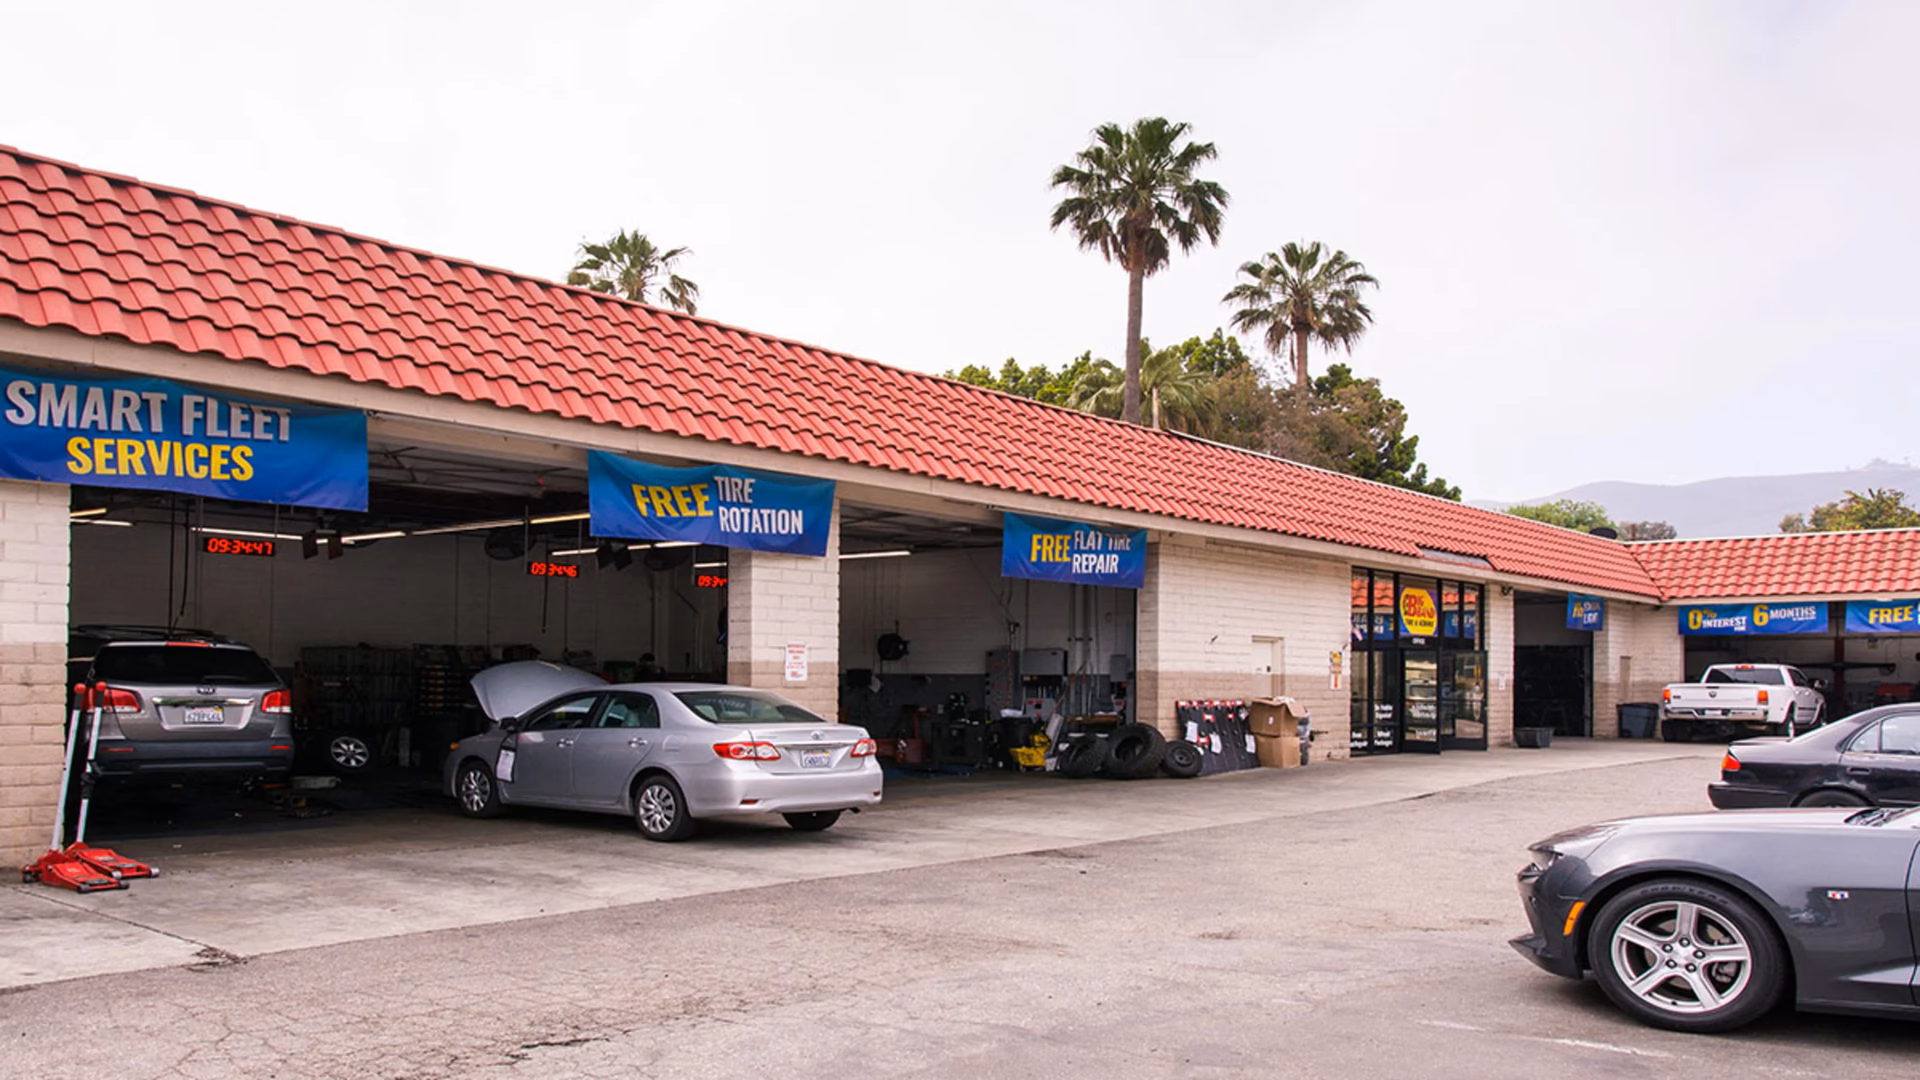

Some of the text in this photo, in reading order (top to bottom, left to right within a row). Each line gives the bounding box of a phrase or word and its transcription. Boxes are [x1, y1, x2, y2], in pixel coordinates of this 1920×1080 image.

[5, 379, 291, 442] SMART FLEET
[66, 435, 254, 481] SERVICES
[631, 483, 713, 517] FREE
[712, 475, 755, 503] TIRE
[718, 505, 803, 534] ROTATION
[207, 537, 273, 555] 09:34:47
[1030, 533, 1071, 562] FREE
[1073, 529, 1103, 551] FLAT
[531, 561, 577, 577] 0934:46
[1072, 553, 1119, 574] REPAIR
[1702, 615, 1747, 629] INTEREST
[1753, 604, 1816, 626] 6 MONTHS
[1868, 605, 1914, 624] FREE
